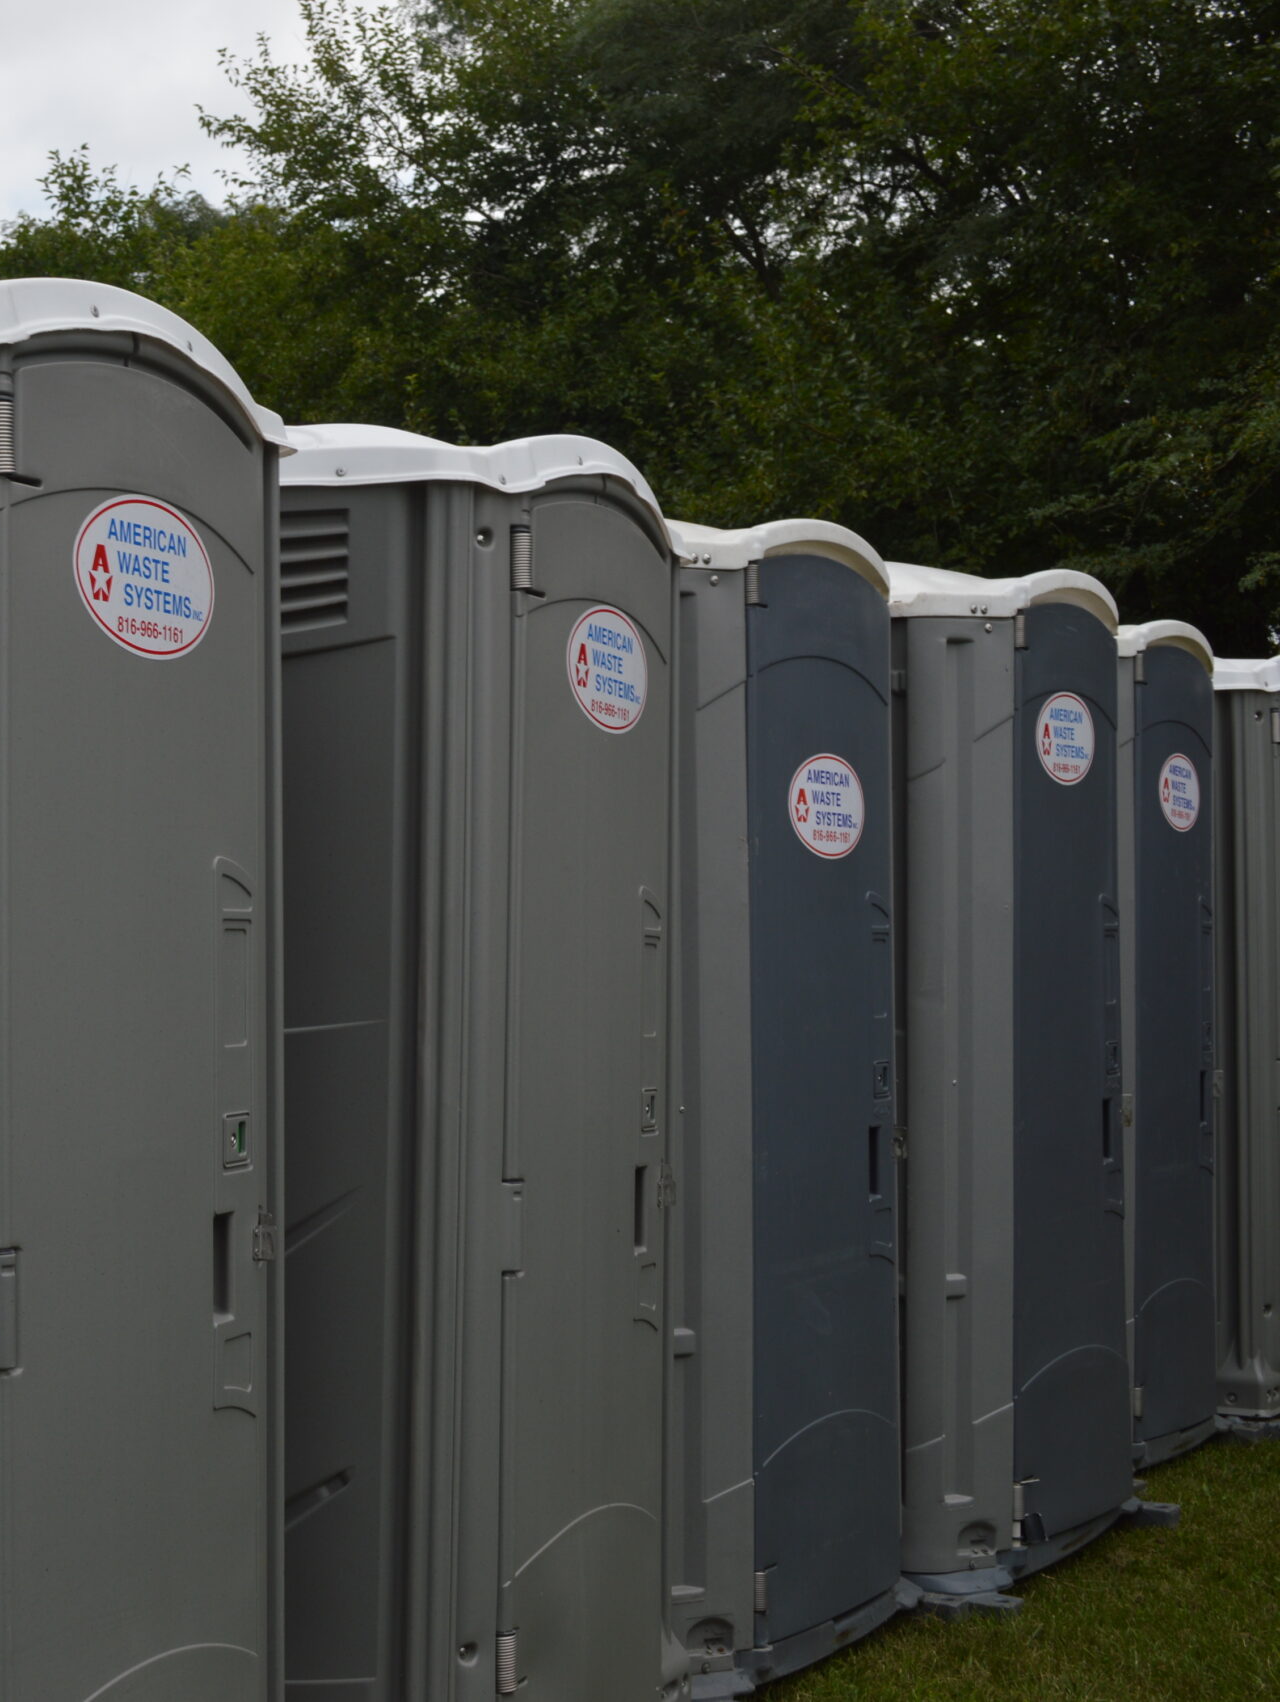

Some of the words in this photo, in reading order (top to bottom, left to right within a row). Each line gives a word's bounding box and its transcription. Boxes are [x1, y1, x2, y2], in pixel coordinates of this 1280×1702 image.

[108, 518, 187, 558] AMERICAN
[117, 551, 170, 583] WASTE
[124, 583, 191, 619] SYSTEMS
[117, 616, 183, 644] 816-966-1161
[587, 623, 633, 654] AMERICAN
[592, 648, 623, 674] WASTE
[595, 674, 635, 702] SYSTEMS
[1050, 708, 1083, 724] AMERICAN
[1053, 726, 1075, 740] WASTE
[1056, 743, 1084, 759] SYSTEMS
[807, 769, 850, 788] AMERICAN
[812, 790, 841, 807] WASTE
[816, 811, 852, 828] SYSTEMS
